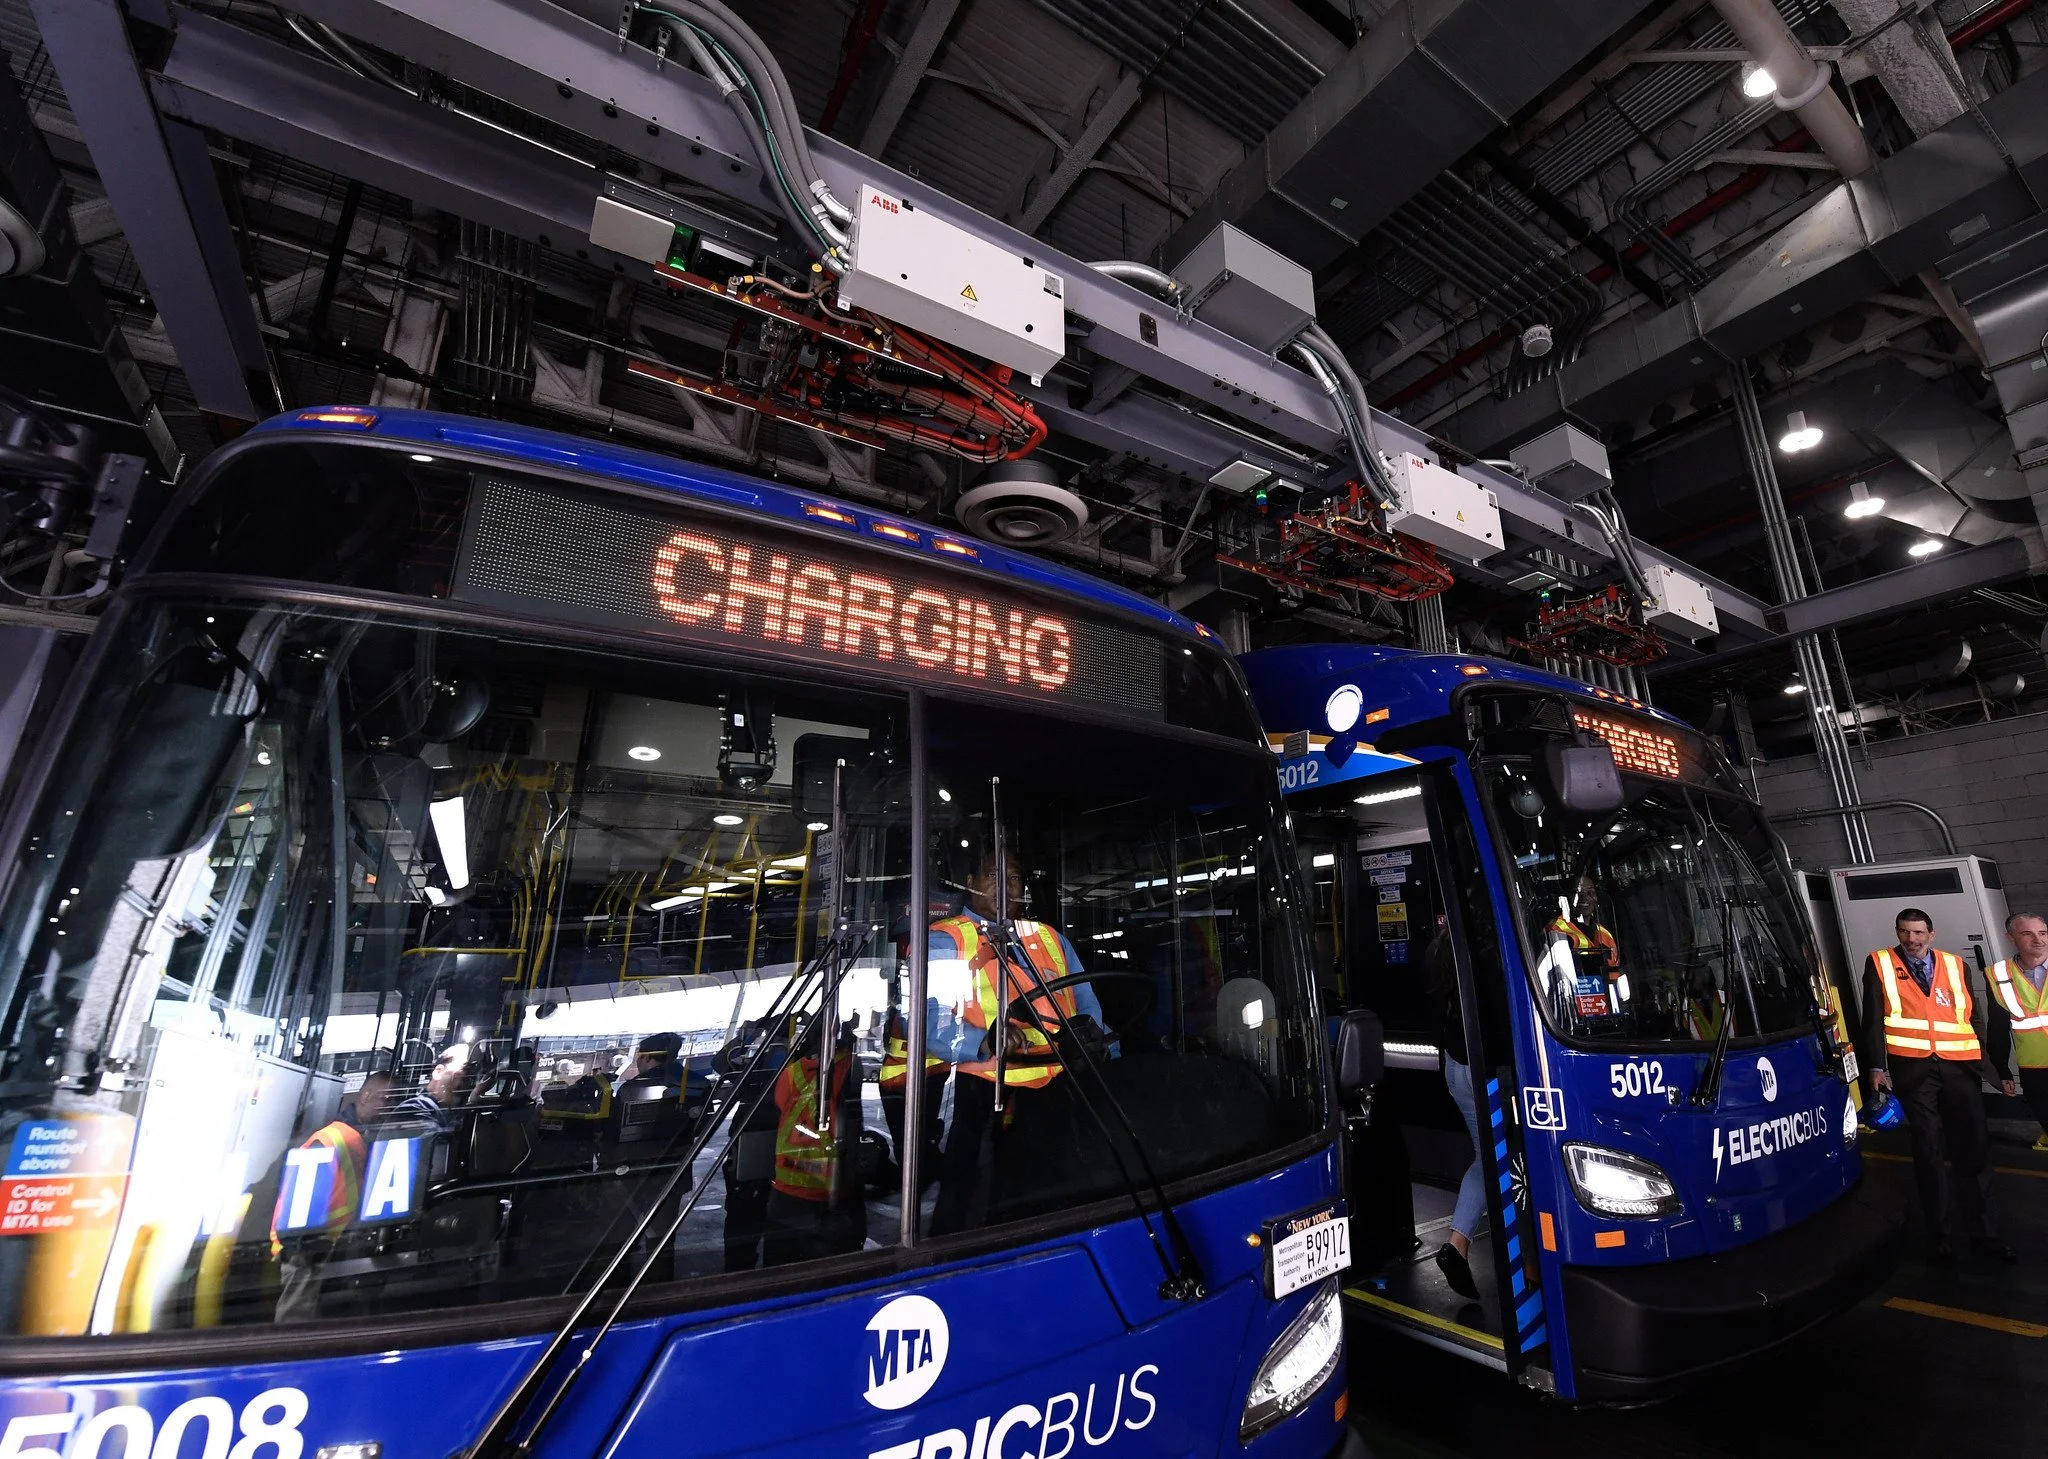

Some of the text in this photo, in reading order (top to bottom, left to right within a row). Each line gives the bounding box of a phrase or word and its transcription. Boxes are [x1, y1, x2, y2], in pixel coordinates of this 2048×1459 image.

[871, 195, 899, 215] ABB
[653, 531, 1070, 691] CHARGING
[1611, 1061, 1665, 1098] 5012
[29, 1127, 78, 1141] Route
[24, 1140, 88, 1156] number
[19, 1157, 72, 1171] above
[11, 1183, 75, 1198] Control
[6, 1198, 56, 1213] ID for
[1, 1214, 75, 1229] MTA use
[1292, 1210, 1331, 1234] NEW YORK
[1278, 1241, 1302, 1255] Metropolitan
[1277, 1252, 1305, 1267] Transportation
[1283, 1265, 1301, 1278] Authority
[1300, 1266, 1330, 1284] NEW YORK
